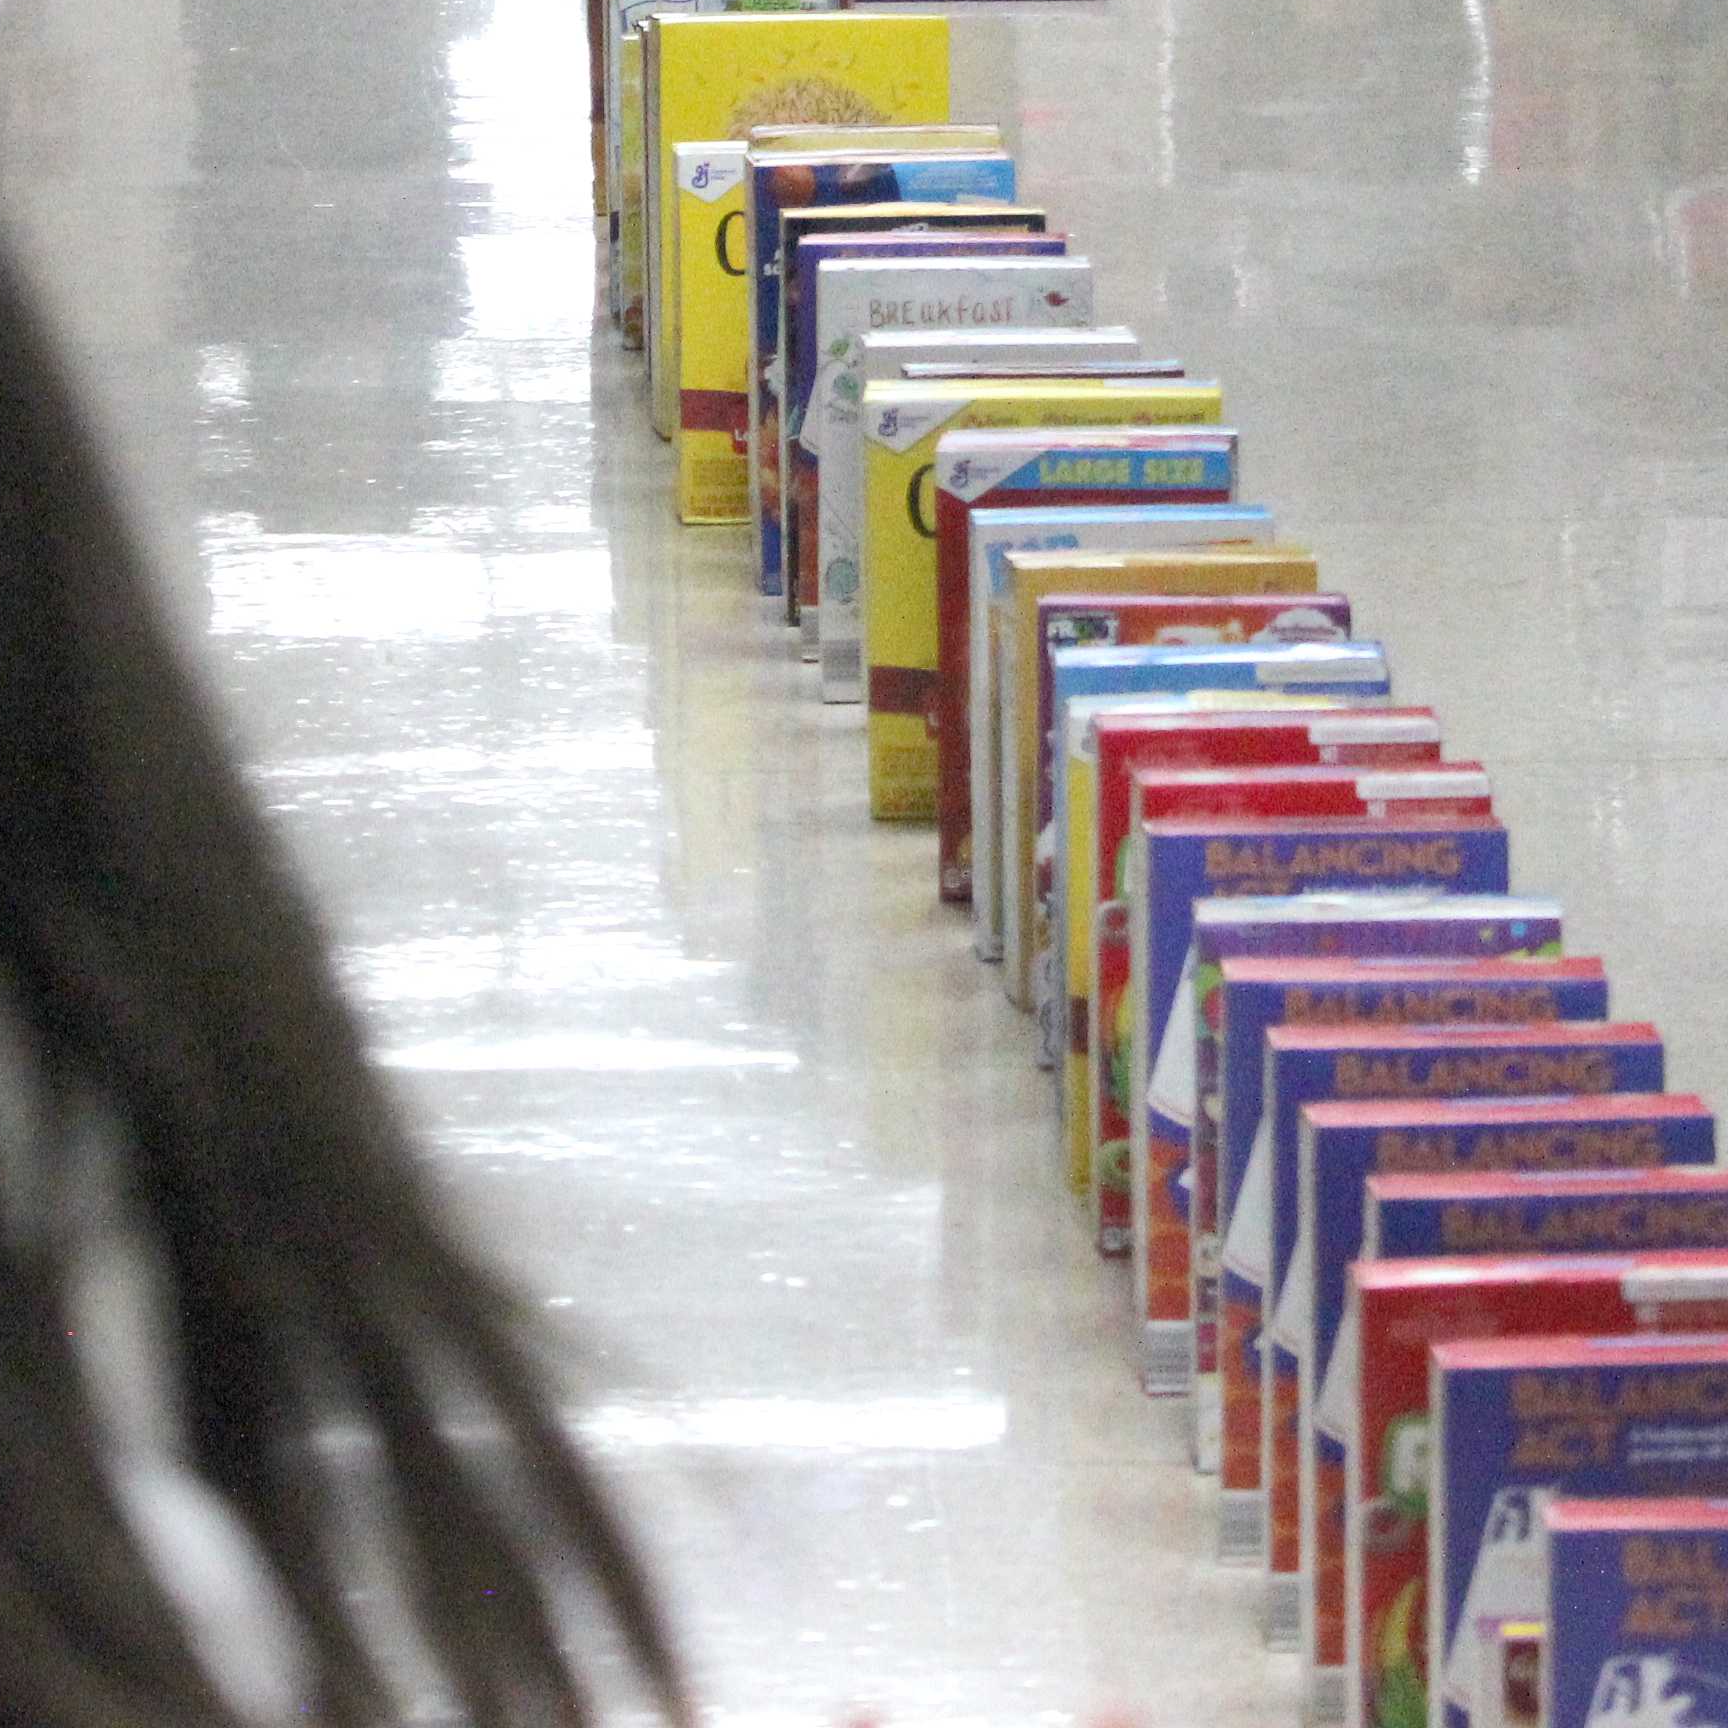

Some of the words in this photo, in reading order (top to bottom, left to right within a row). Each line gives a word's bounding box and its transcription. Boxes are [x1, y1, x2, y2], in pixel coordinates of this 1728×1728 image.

[1038, 458, 1130, 485] LARGE
[1143, 457, 1205, 484] SIZE
[1205, 838, 1462, 880] BALANCING
[1284, 988, 1560, 1025] BALANCING
[1336, 1052, 1614, 1095] BALANCING
[1377, 1125, 1663, 1171] BALANCING
[1511, 1415, 1616, 1466] ACT
